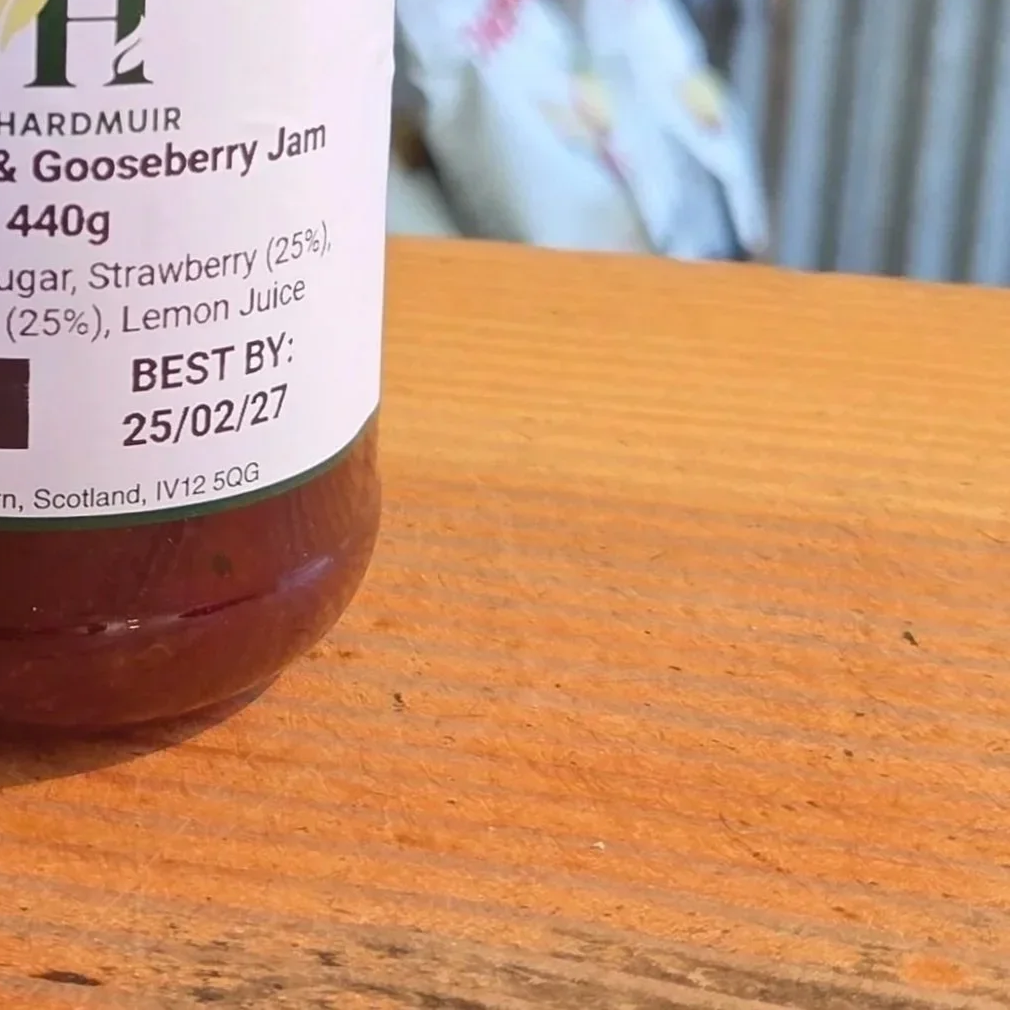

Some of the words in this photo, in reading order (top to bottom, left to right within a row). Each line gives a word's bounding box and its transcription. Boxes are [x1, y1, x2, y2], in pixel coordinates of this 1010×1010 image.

[32, 141, 257, 183] Gooseberry
[268, 125, 325, 161] Jam
[6, 204, 109, 245] 440g
[88, 250, 257, 290] Strawberry
[267, 221, 331, 273] (25%),
[6, 304, 110, 343] (25%),
[122, 300, 228, 332] Lemon
[239, 280, 305, 316] Juice
[132, 346, 234, 392] BEST
[245, 332, 293, 375] BY:
[122, 383, 287, 446] 25/02/27
[34, 484, 146, 509] Scotland,
[157, 475, 206, 502] IV12
[213, 462, 260, 492] 5QG
